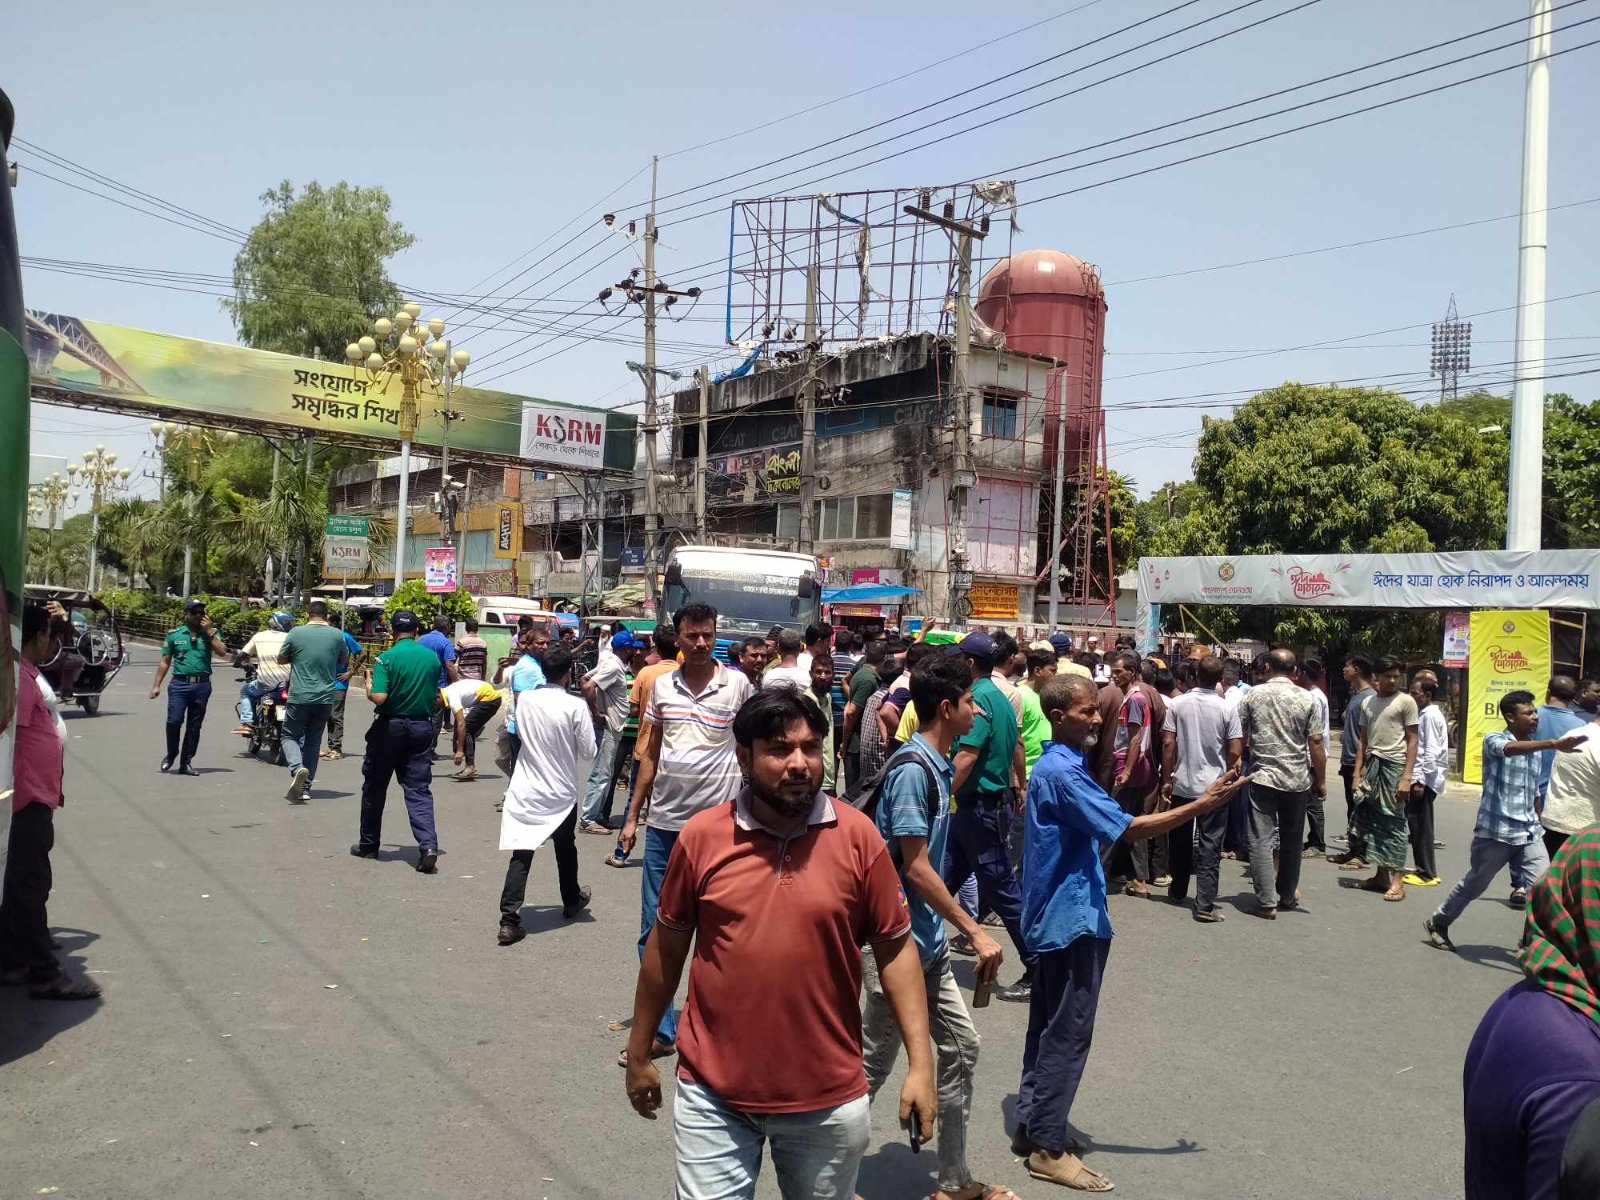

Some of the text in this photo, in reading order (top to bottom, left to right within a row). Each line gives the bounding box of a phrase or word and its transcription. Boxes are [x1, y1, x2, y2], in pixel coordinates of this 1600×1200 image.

[293, 369, 368, 396] সংযোগে
[291, 393, 419, 428] সমৃদ্ধির শিখ
[536, 413, 602, 446] KSRM
[559, 443, 577, 454] থেকে
[578, 446, 600, 458] শিখরে
[767, 449, 801, 475] বাংলা
[500, 509, 511, 550] AKHTAR
[332, 546, 361, 558] KSRM
[1372, 569, 1590, 589] ঈদের যাত্রা হোক নিরাপদ ও আনন্দময়
